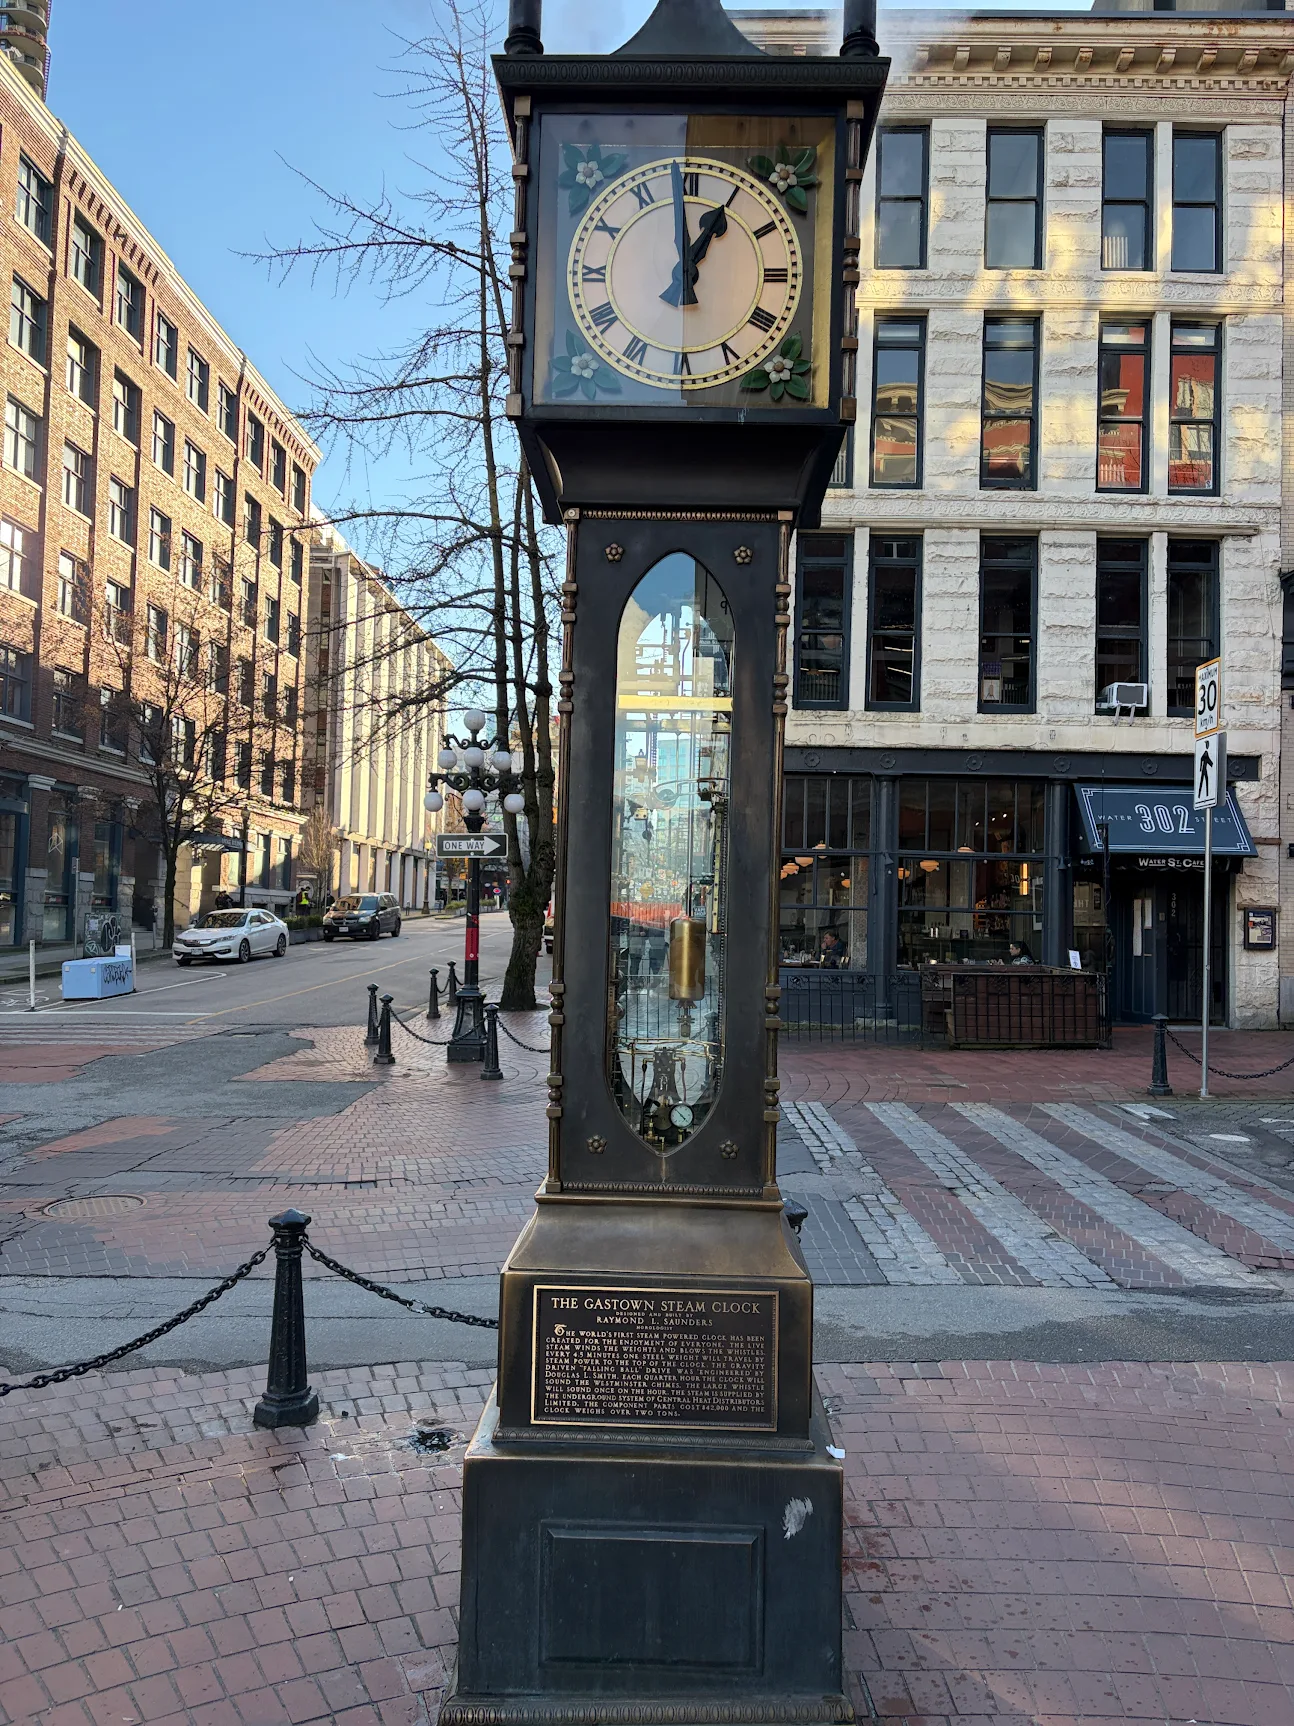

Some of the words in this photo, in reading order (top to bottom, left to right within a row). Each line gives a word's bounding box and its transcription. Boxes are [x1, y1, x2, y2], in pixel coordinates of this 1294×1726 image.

[1198, 680, 1217, 716] 30
[1199, 714, 1214, 727] km/h
[1134, 804, 1196, 834] 302
[1195, 816, 1232, 824] STEET
[444, 842, 463, 850] ONE
[466, 842, 485, 850] WAY
[1138, 857, 1166, 867] WATER
[1167, 858, 1182, 867] ST.
[551, 1297, 578, 1308] THE
[584, 1298, 654, 1310] GASTOWN
[661, 1300, 705, 1311] STEAM
[712, 1301, 760, 1313] CLOCK
[597, 1316, 644, 1324] RAYMOND
[554, 1324, 575, 1336] THE
